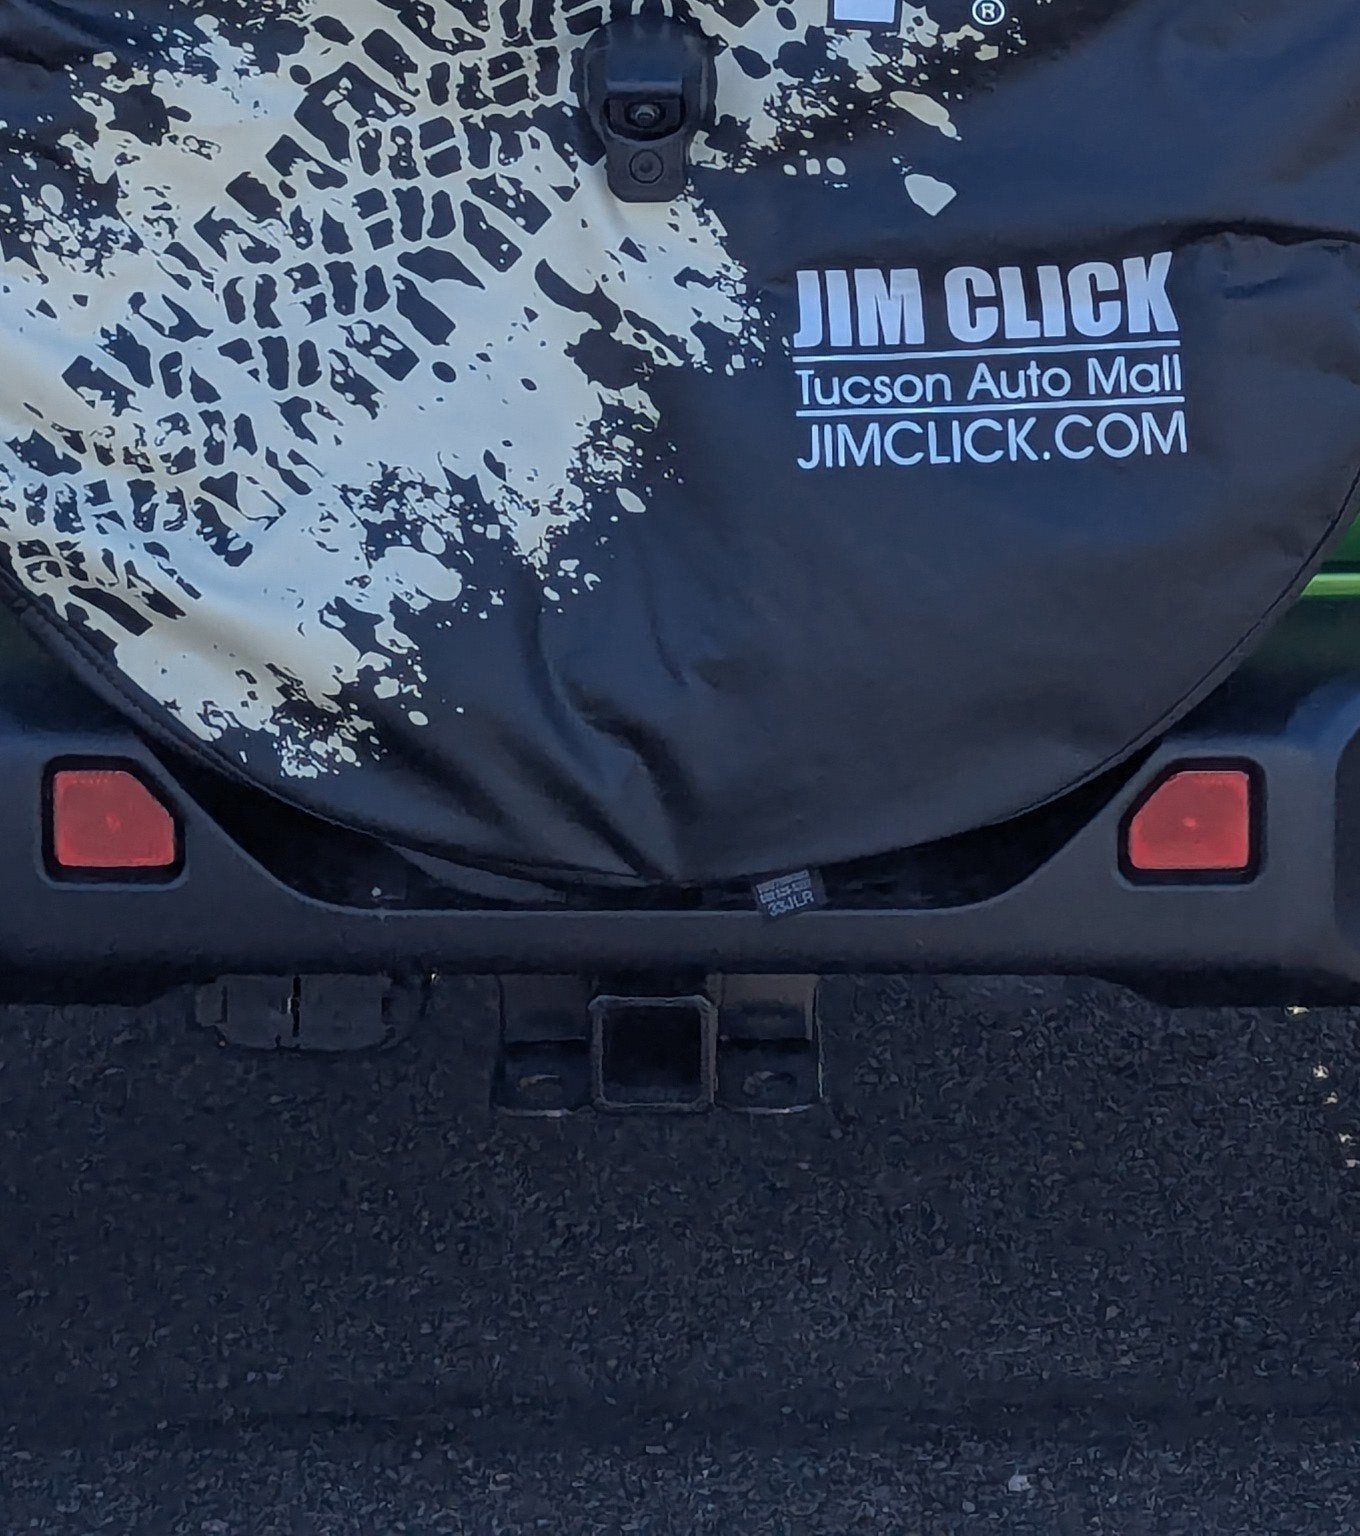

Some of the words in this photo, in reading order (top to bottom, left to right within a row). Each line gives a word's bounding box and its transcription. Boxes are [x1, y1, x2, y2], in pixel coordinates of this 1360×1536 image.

[793, 268, 925, 348] JIM
[944, 251, 1179, 343] CLICK
[796, 366, 952, 406] Tucson
[967, 360, 1071, 400] Auto
[1087, 354, 1182, 395] Mall
[797, 410, 1188, 470] JIMCLICK.COM
